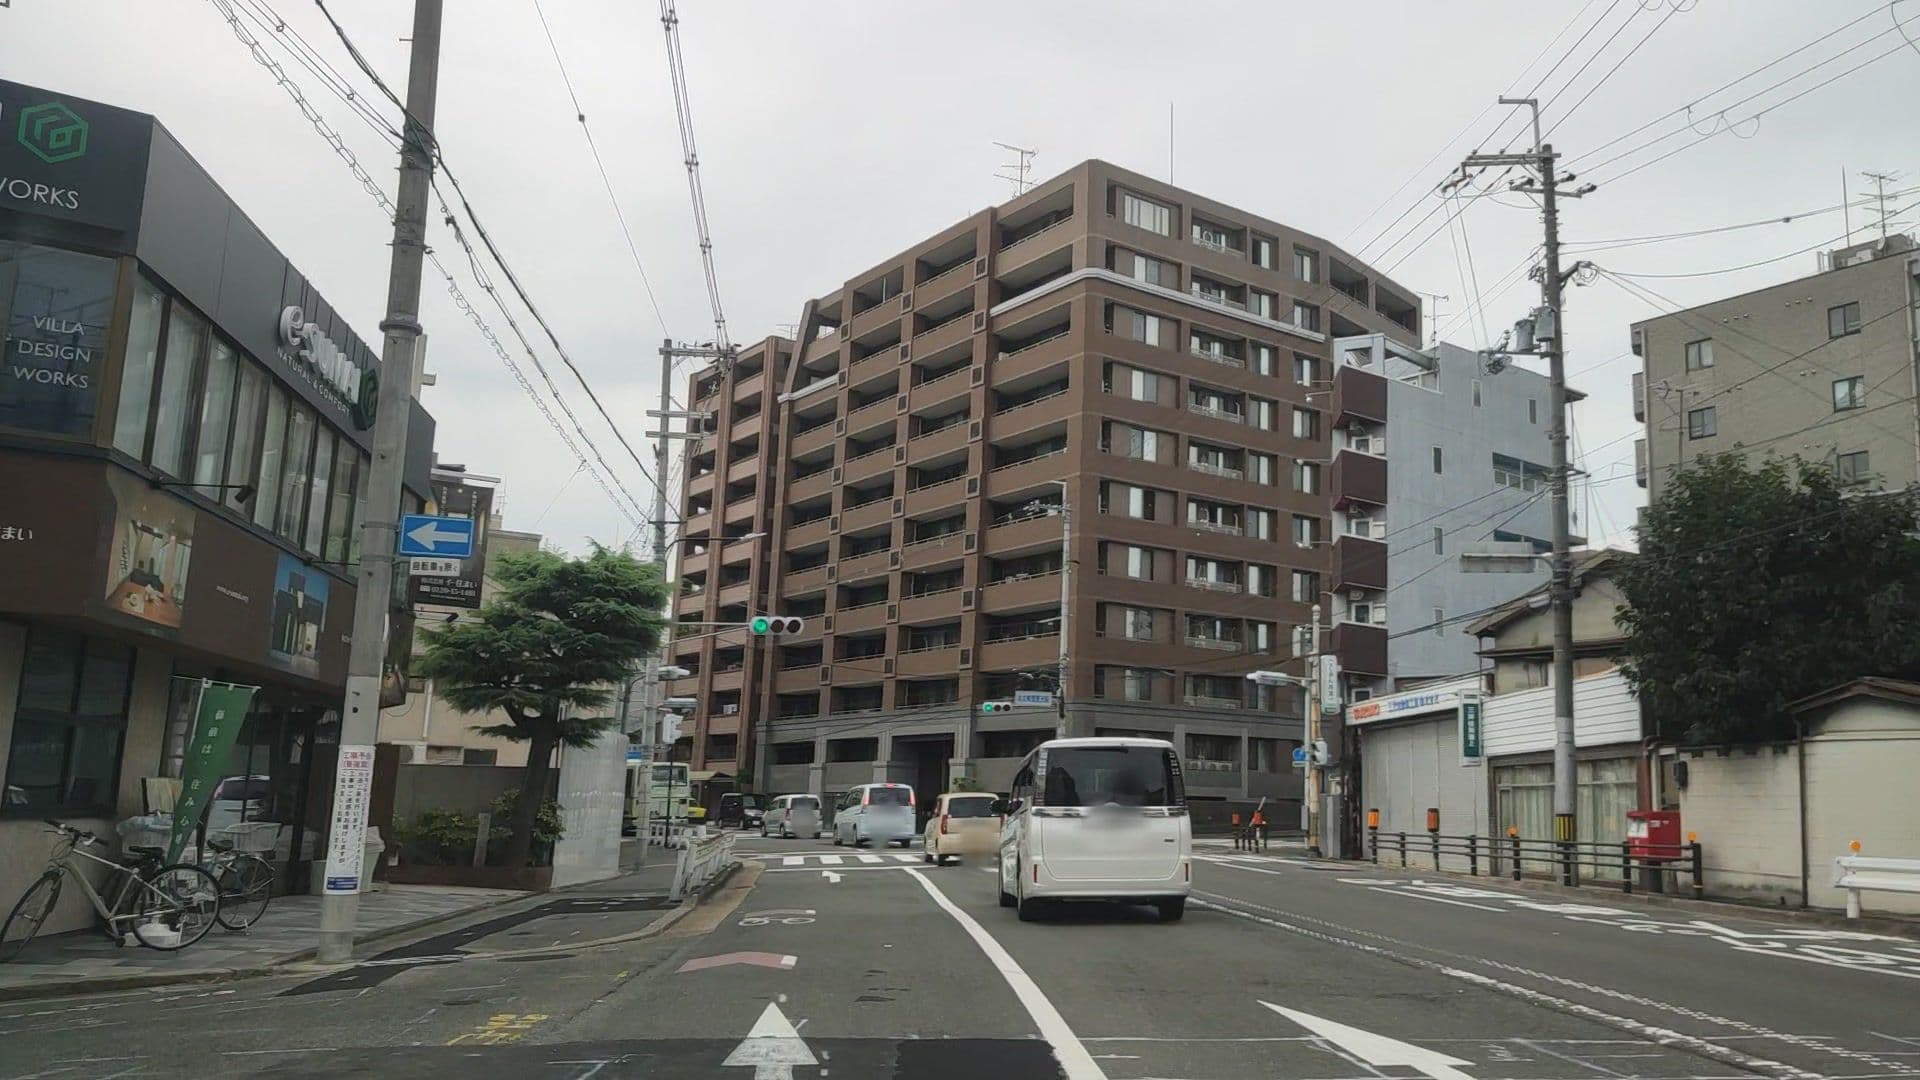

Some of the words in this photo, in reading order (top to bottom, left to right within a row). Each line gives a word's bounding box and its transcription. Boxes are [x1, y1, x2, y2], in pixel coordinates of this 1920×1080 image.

[33, 315, 85, 336] VILLA
[18, 340, 91, 363] DESIGN
[13, 366, 89, 389] WORKS
[0, 525, 33, 541] まい
